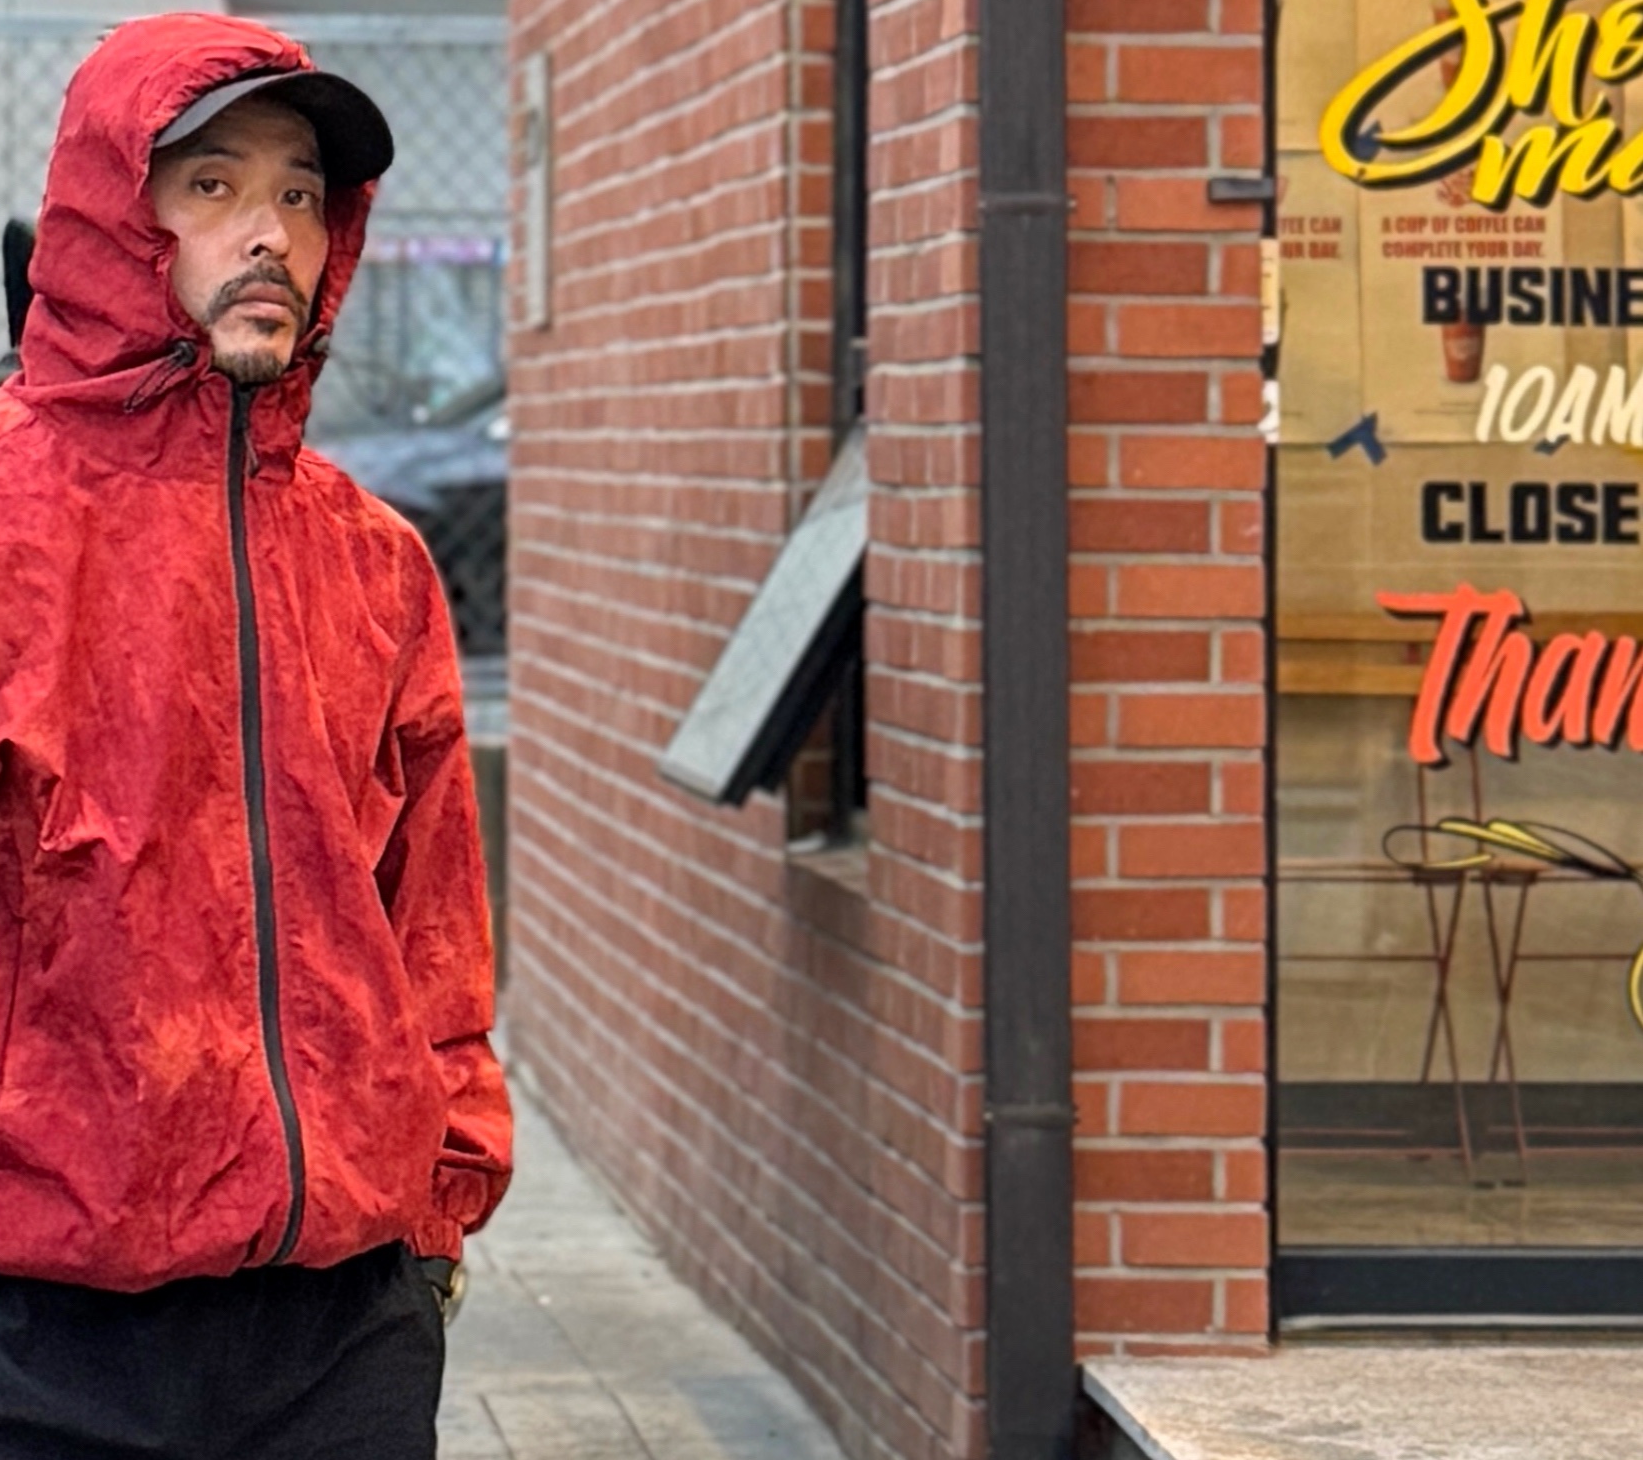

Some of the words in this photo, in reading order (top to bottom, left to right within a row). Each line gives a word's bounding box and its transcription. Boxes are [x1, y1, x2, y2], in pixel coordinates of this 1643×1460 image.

[1395, 216, 1428, 234] CUP
[1454, 216, 1509, 234] COFFEE
[1513, 216, 1546, 234] CAN
[1382, 240, 1462, 258] COMPLETE
[1466, 240, 1509, 258] YOUR
[1422, 266, 1643, 326] BUSINE
[1421, 481, 1641, 545] CLOSE
